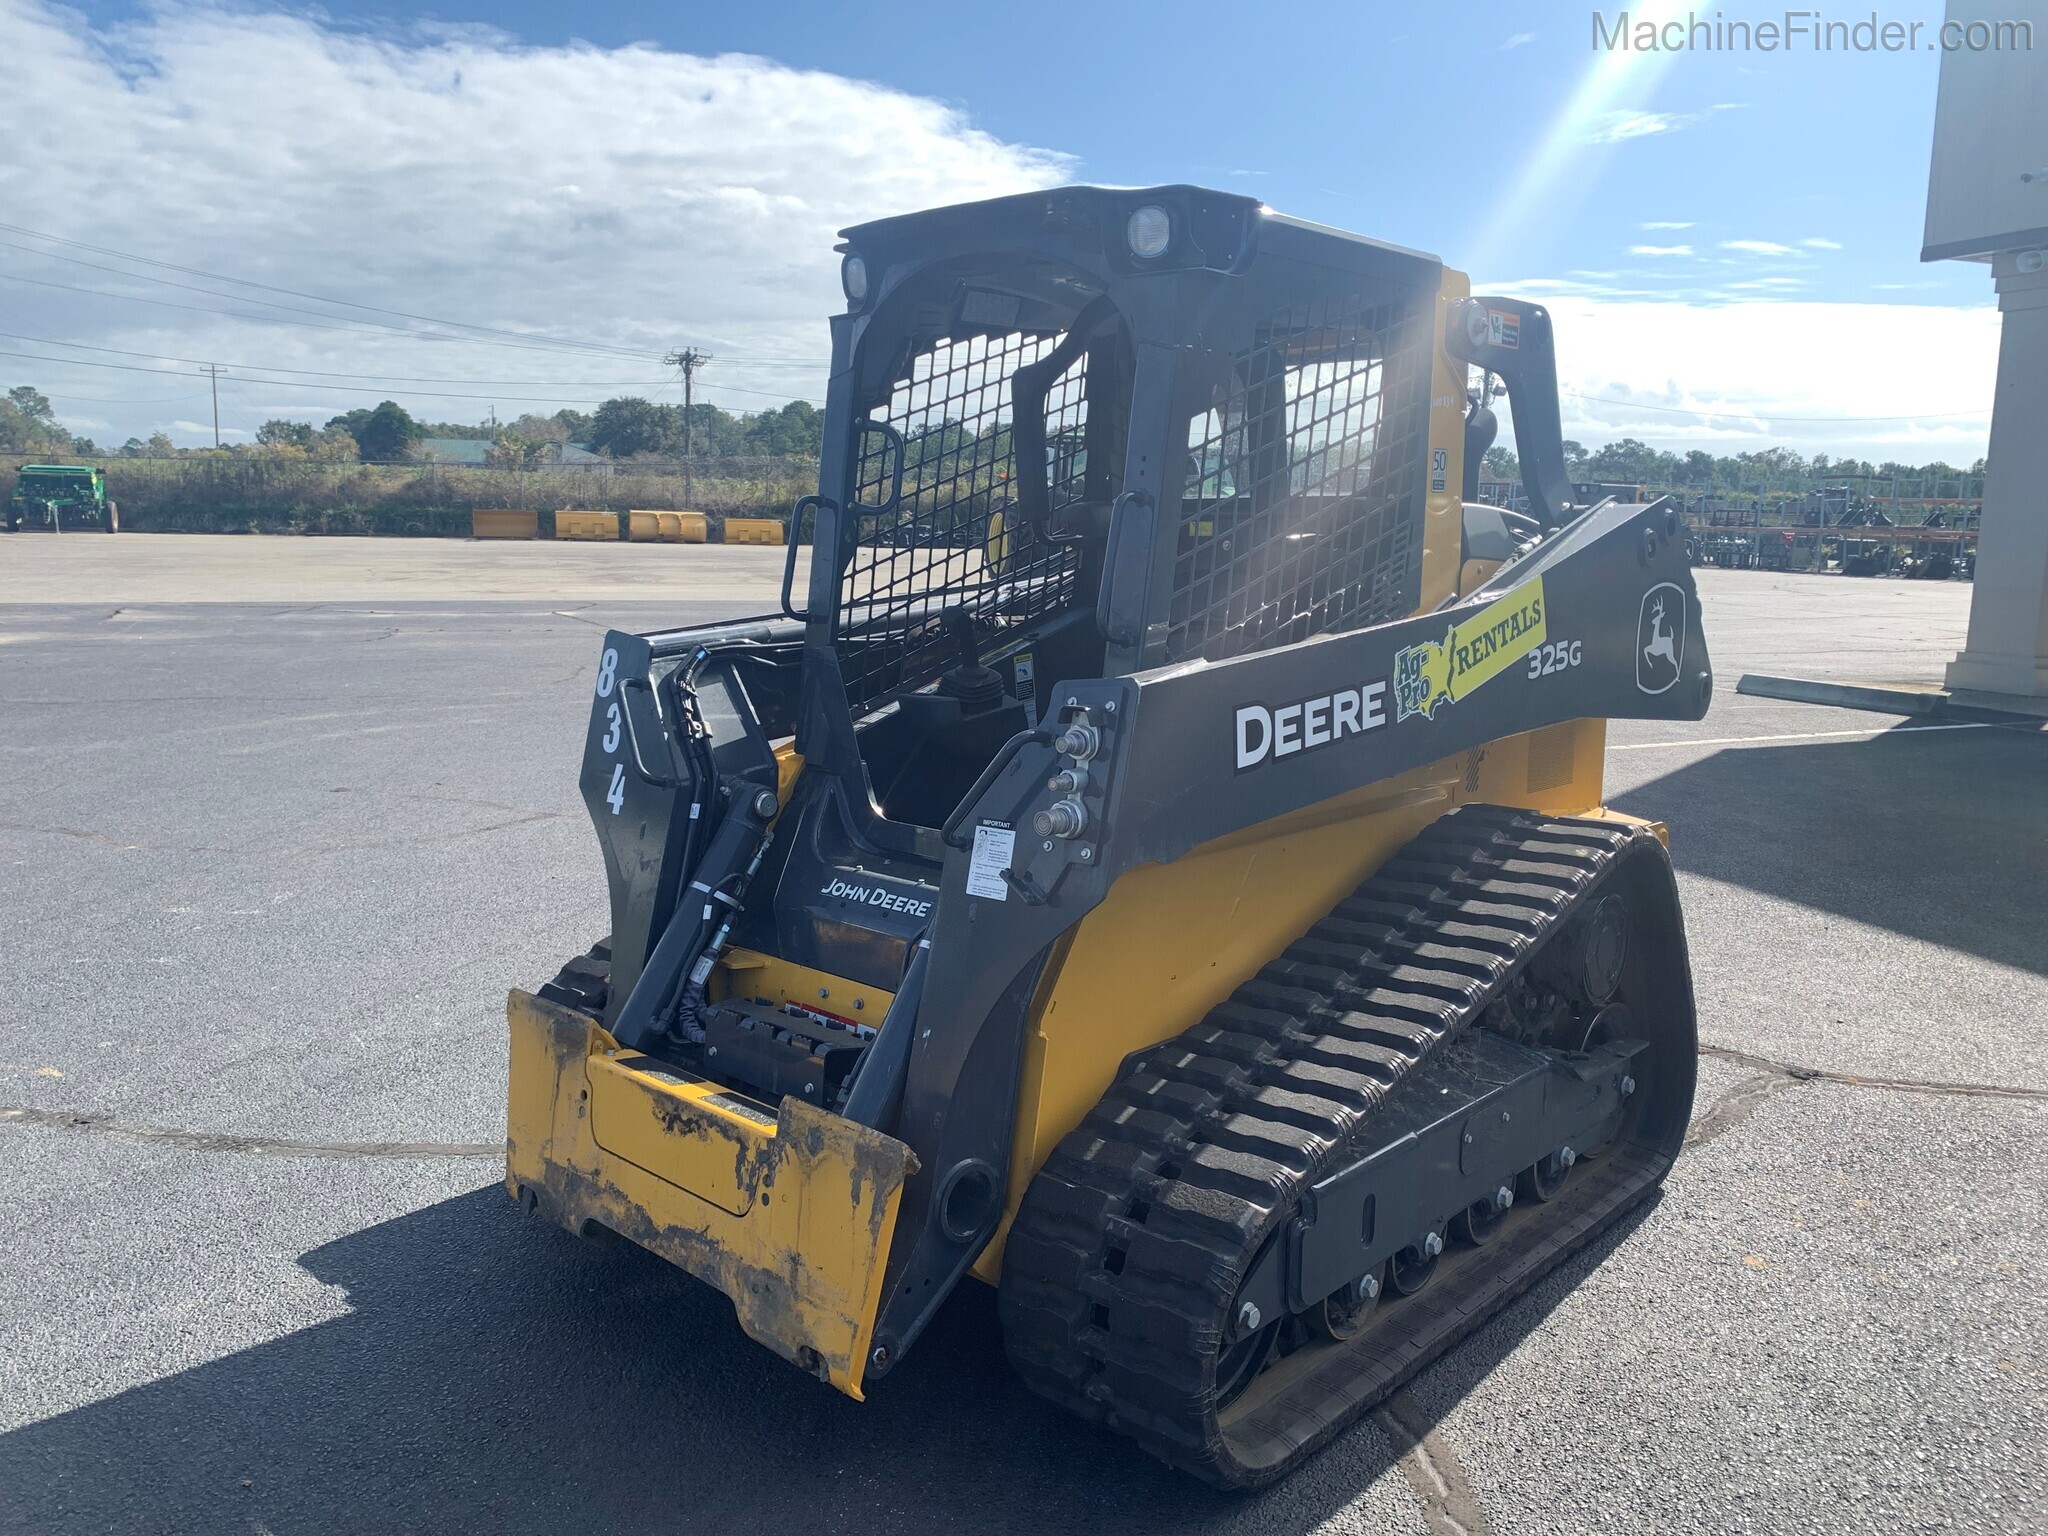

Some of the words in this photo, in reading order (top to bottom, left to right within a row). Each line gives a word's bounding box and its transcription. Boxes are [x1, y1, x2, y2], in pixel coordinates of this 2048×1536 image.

[1434, 450, 1447, 471] 50
[1457, 597, 1542, 677] RENTALS
[1398, 648, 1429, 688] Ag-
[1527, 640, 1582, 680] 325G
[1399, 676, 1431, 718] Pro
[1236, 681, 1386, 769] DEERE
[982, 818, 1011, 829] IMPORTANT
[820, 877, 868, 902] JOHN
[868, 888, 932, 918] DEERE
